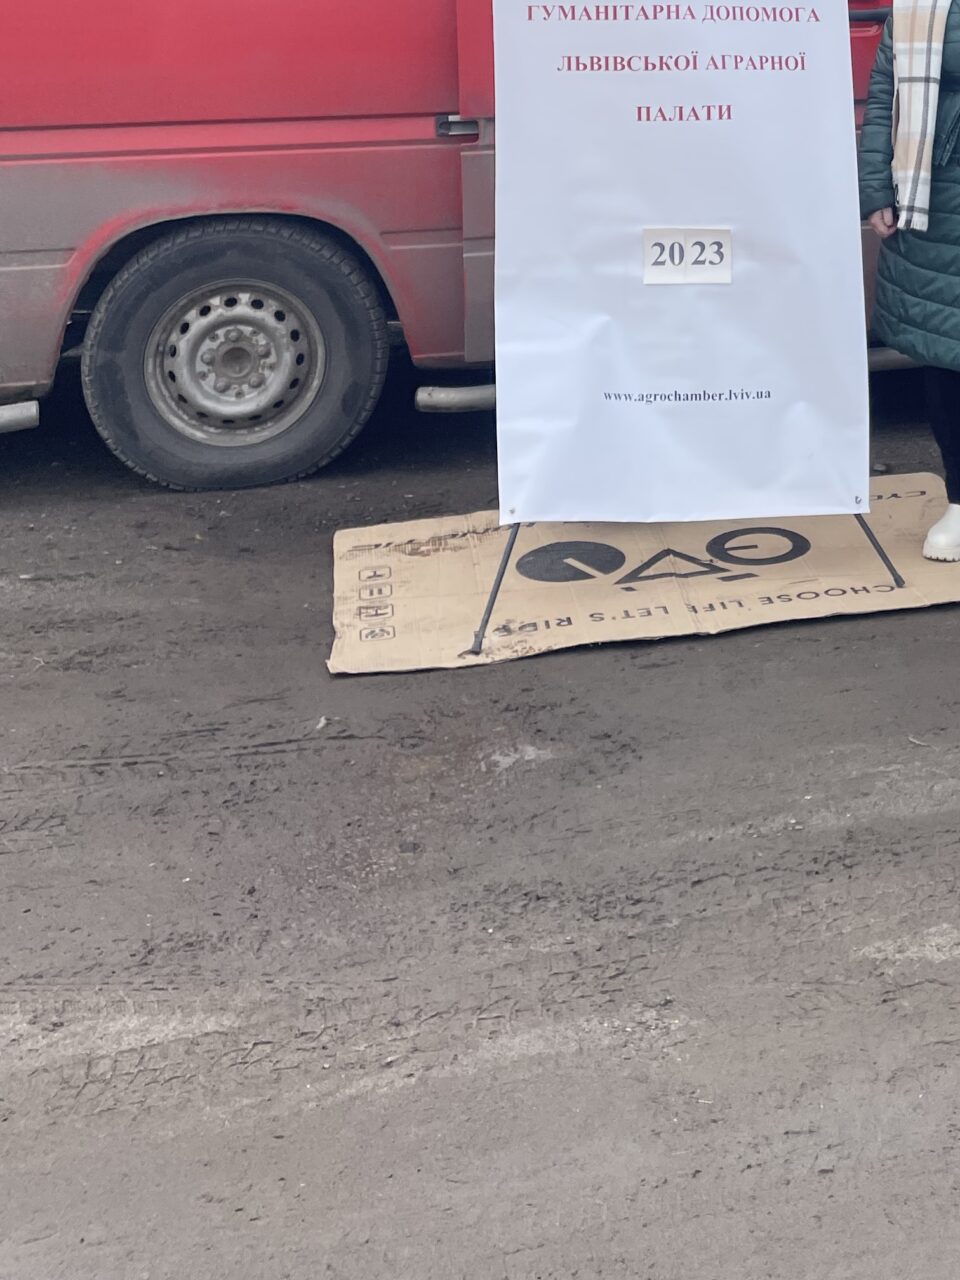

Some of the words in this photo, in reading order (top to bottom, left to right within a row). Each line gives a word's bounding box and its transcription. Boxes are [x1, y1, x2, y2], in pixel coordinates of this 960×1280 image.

[526, 4, 697, 22] ГУМАНІТАРНА
[701, 4, 821, 24] ДОПОМОГА
[556, 51, 699, 72] ЛЬВІВСЬКОЇ
[705, 51, 807, 71] АГРАРНОЇ
[636, 104, 732, 122] ПАЛАТИ
[650, 240, 725, 266] 2023
[603, 388, 771, 404] www.agrochamber.lviv.ua
[758, 584, 896, 606] CHOOSE
[588, 605, 670, 623] LET'S
[685, 599, 745, 614] LIFE
